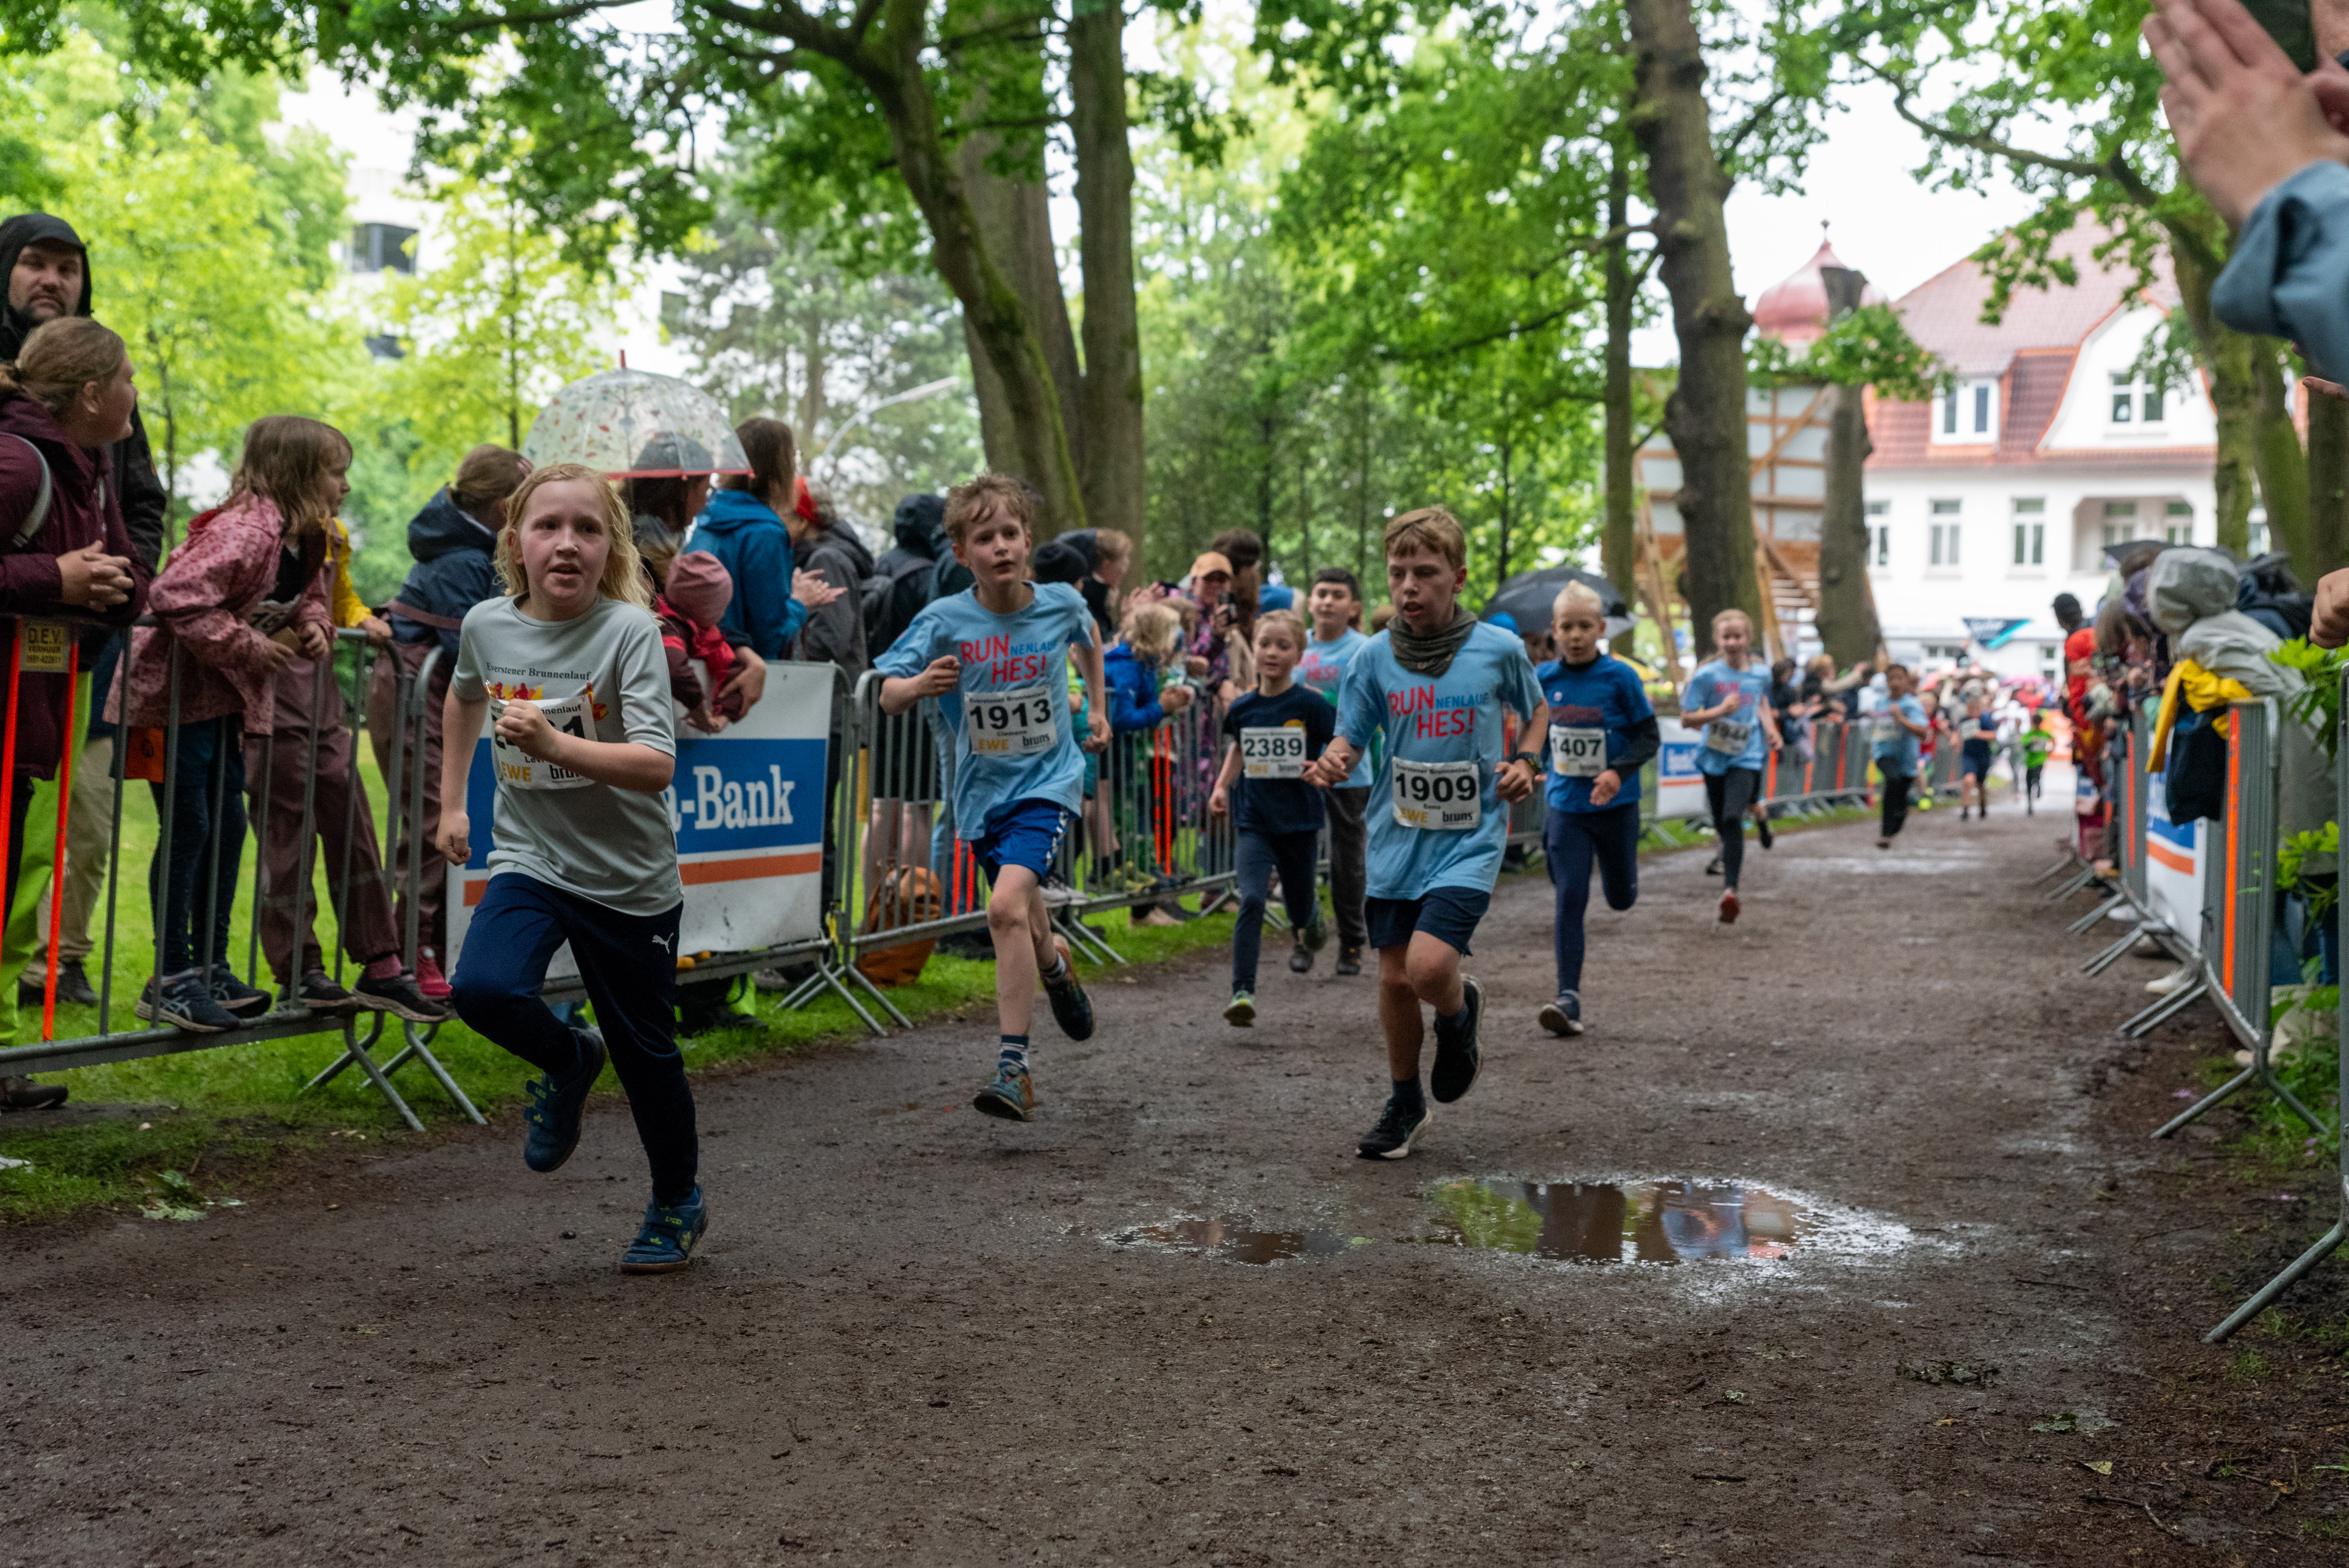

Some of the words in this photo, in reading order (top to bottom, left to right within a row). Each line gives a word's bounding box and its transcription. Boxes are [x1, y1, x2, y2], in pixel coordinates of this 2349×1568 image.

[961, 634, 1009, 665] RUN
[486, 662, 526, 675] Everstener
[528, 668, 591, 680] Brunnenlauf
[992, 654, 1046, 684] HES!
[970, 699, 1051, 729] 1913
[1389, 684, 1434, 717] RUN
[1417, 708, 1474, 739] HES!
[978, 739, 1009, 751] EWE
[1244, 738, 1302, 757] 2389
[1552, 738, 1601, 757] 1407
[549, 764, 579, 779] bru
[1396, 773, 1476, 802] 1909
